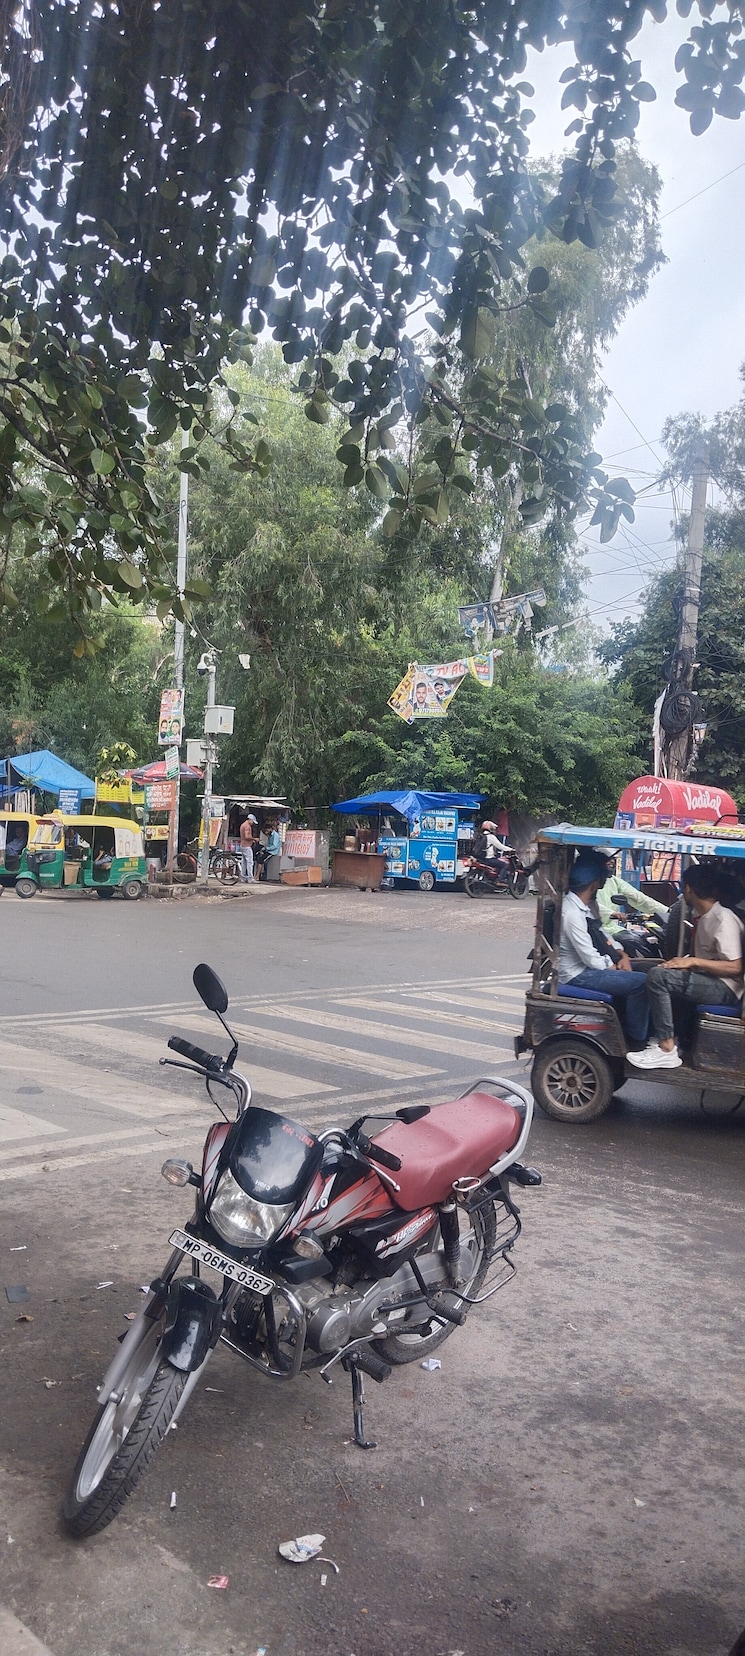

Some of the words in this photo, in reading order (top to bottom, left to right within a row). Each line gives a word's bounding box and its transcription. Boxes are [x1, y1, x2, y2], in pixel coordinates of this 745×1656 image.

[636, 782, 661, 795] waah!
[633, 795, 663, 813] Vadilal
[682, 786, 722, 818] Vadilal
[632, 838, 717, 855] FIGHTER
[255, 1179, 271, 1191] Hero
[182, 1239, 201, 1254] MP
[203, 1251, 235, 1275] 06MS
[237, 1271, 271, 1292] 0367
